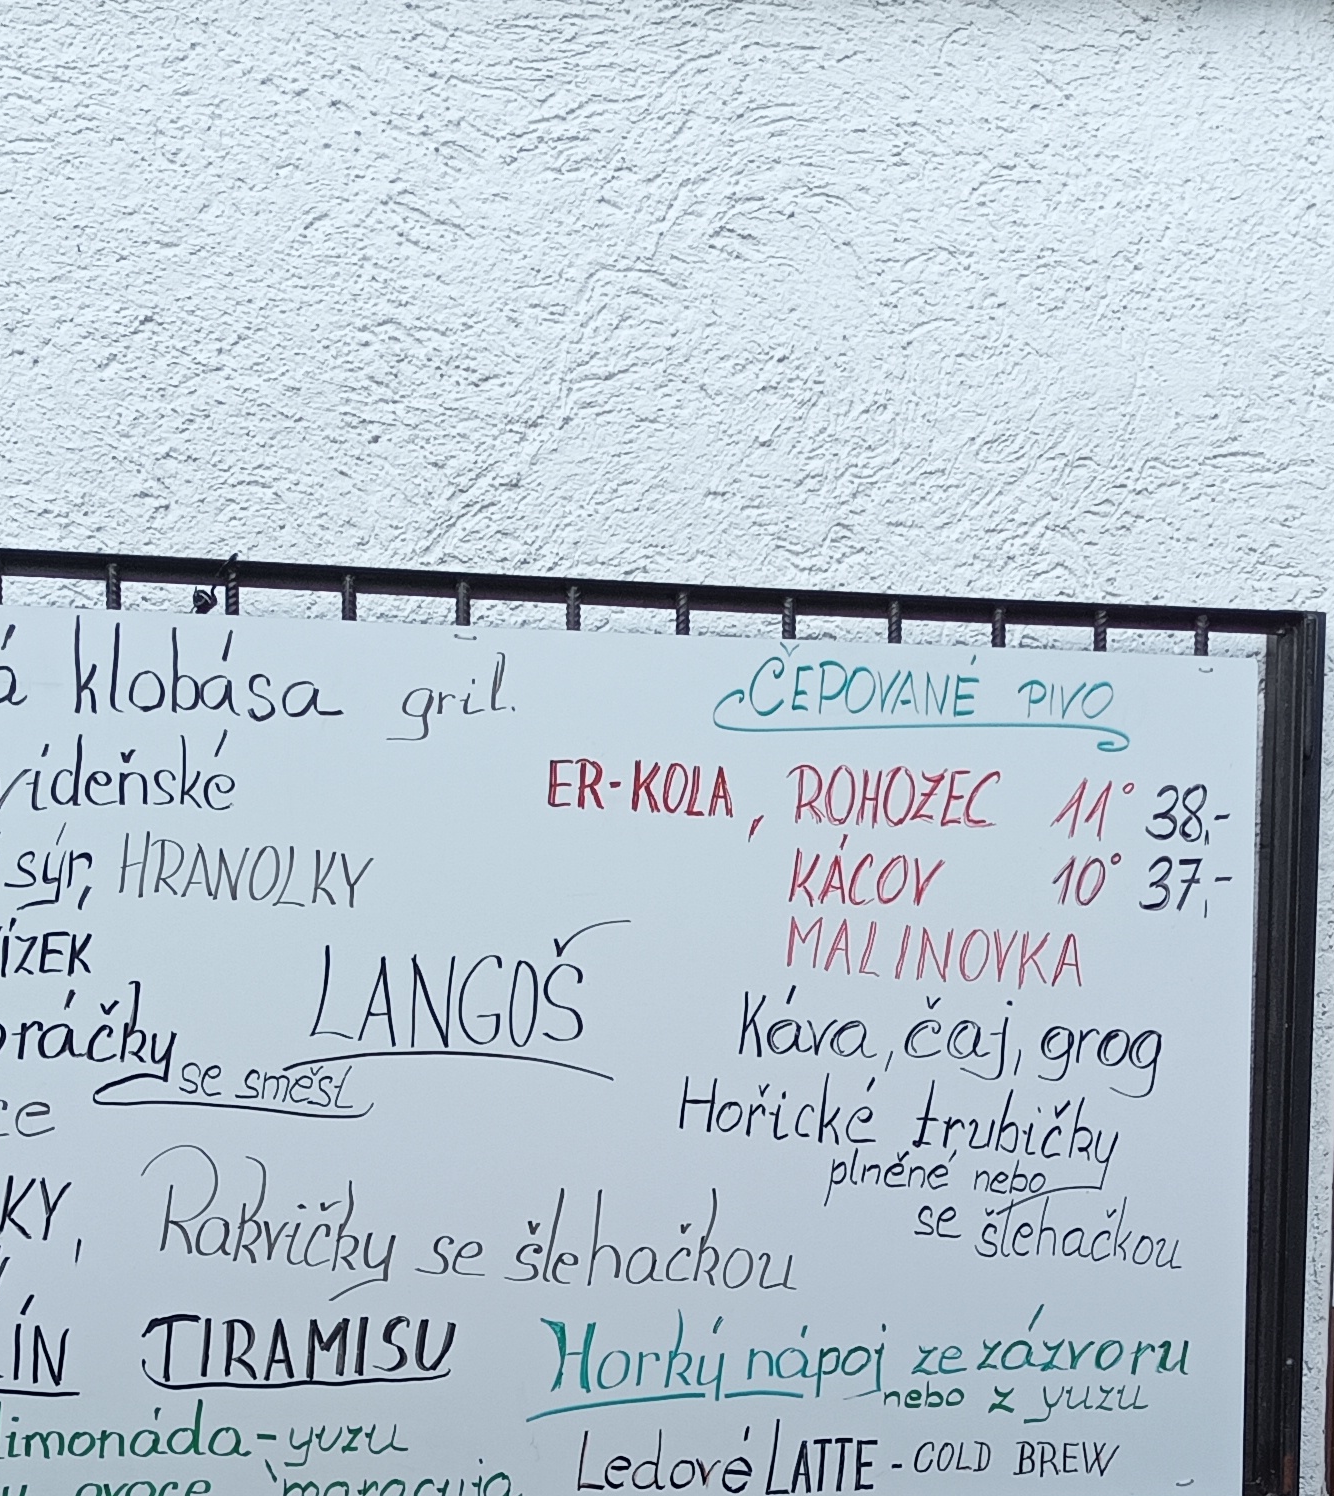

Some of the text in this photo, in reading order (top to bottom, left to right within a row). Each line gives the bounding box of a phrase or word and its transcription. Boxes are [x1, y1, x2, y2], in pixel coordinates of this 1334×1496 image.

[73, 614, 344, 722] klobása
[749, 641, 1116, 719] ČEPOVANÉ PIVO
[786, 764, 1002, 828] ROHOZEC
[1145, 783, 1230, 846] 38,-
[119, 831, 374, 908] HRANOLKY
[788, 833, 1233, 918] KÁCOV 10° 37,-
[786, 915, 1083, 990] MALINOVKA
[310, 938, 587, 1049] LANGOŠ
[178, 1062, 223, 1097] se
[738, 986, 894, 1072] Káva,
[1038, 1023, 1164, 1098] grog
[677, 1073, 1120, 1190] Hořické trubičky
[823, 1149, 1047, 1207] plněné nebo
[140, 1144, 798, 1301] Rakvičky se šlehačkou
[914, 1197, 1183, 1271] se šlehačkou
[142, 1314, 457, 1383] TIRAMISU
[541, 1303, 1190, 1404] Horký nápoj ze zázvoru
[882, 1382, 1150, 1425] nebo z yuzu
[578, 1425, 752, 1494] Ledové
[765, 1418, 878, 1496] LATTE
[913, 1439, 992, 1474] COLD
[1013, 1438, 1121, 1478] BREW
